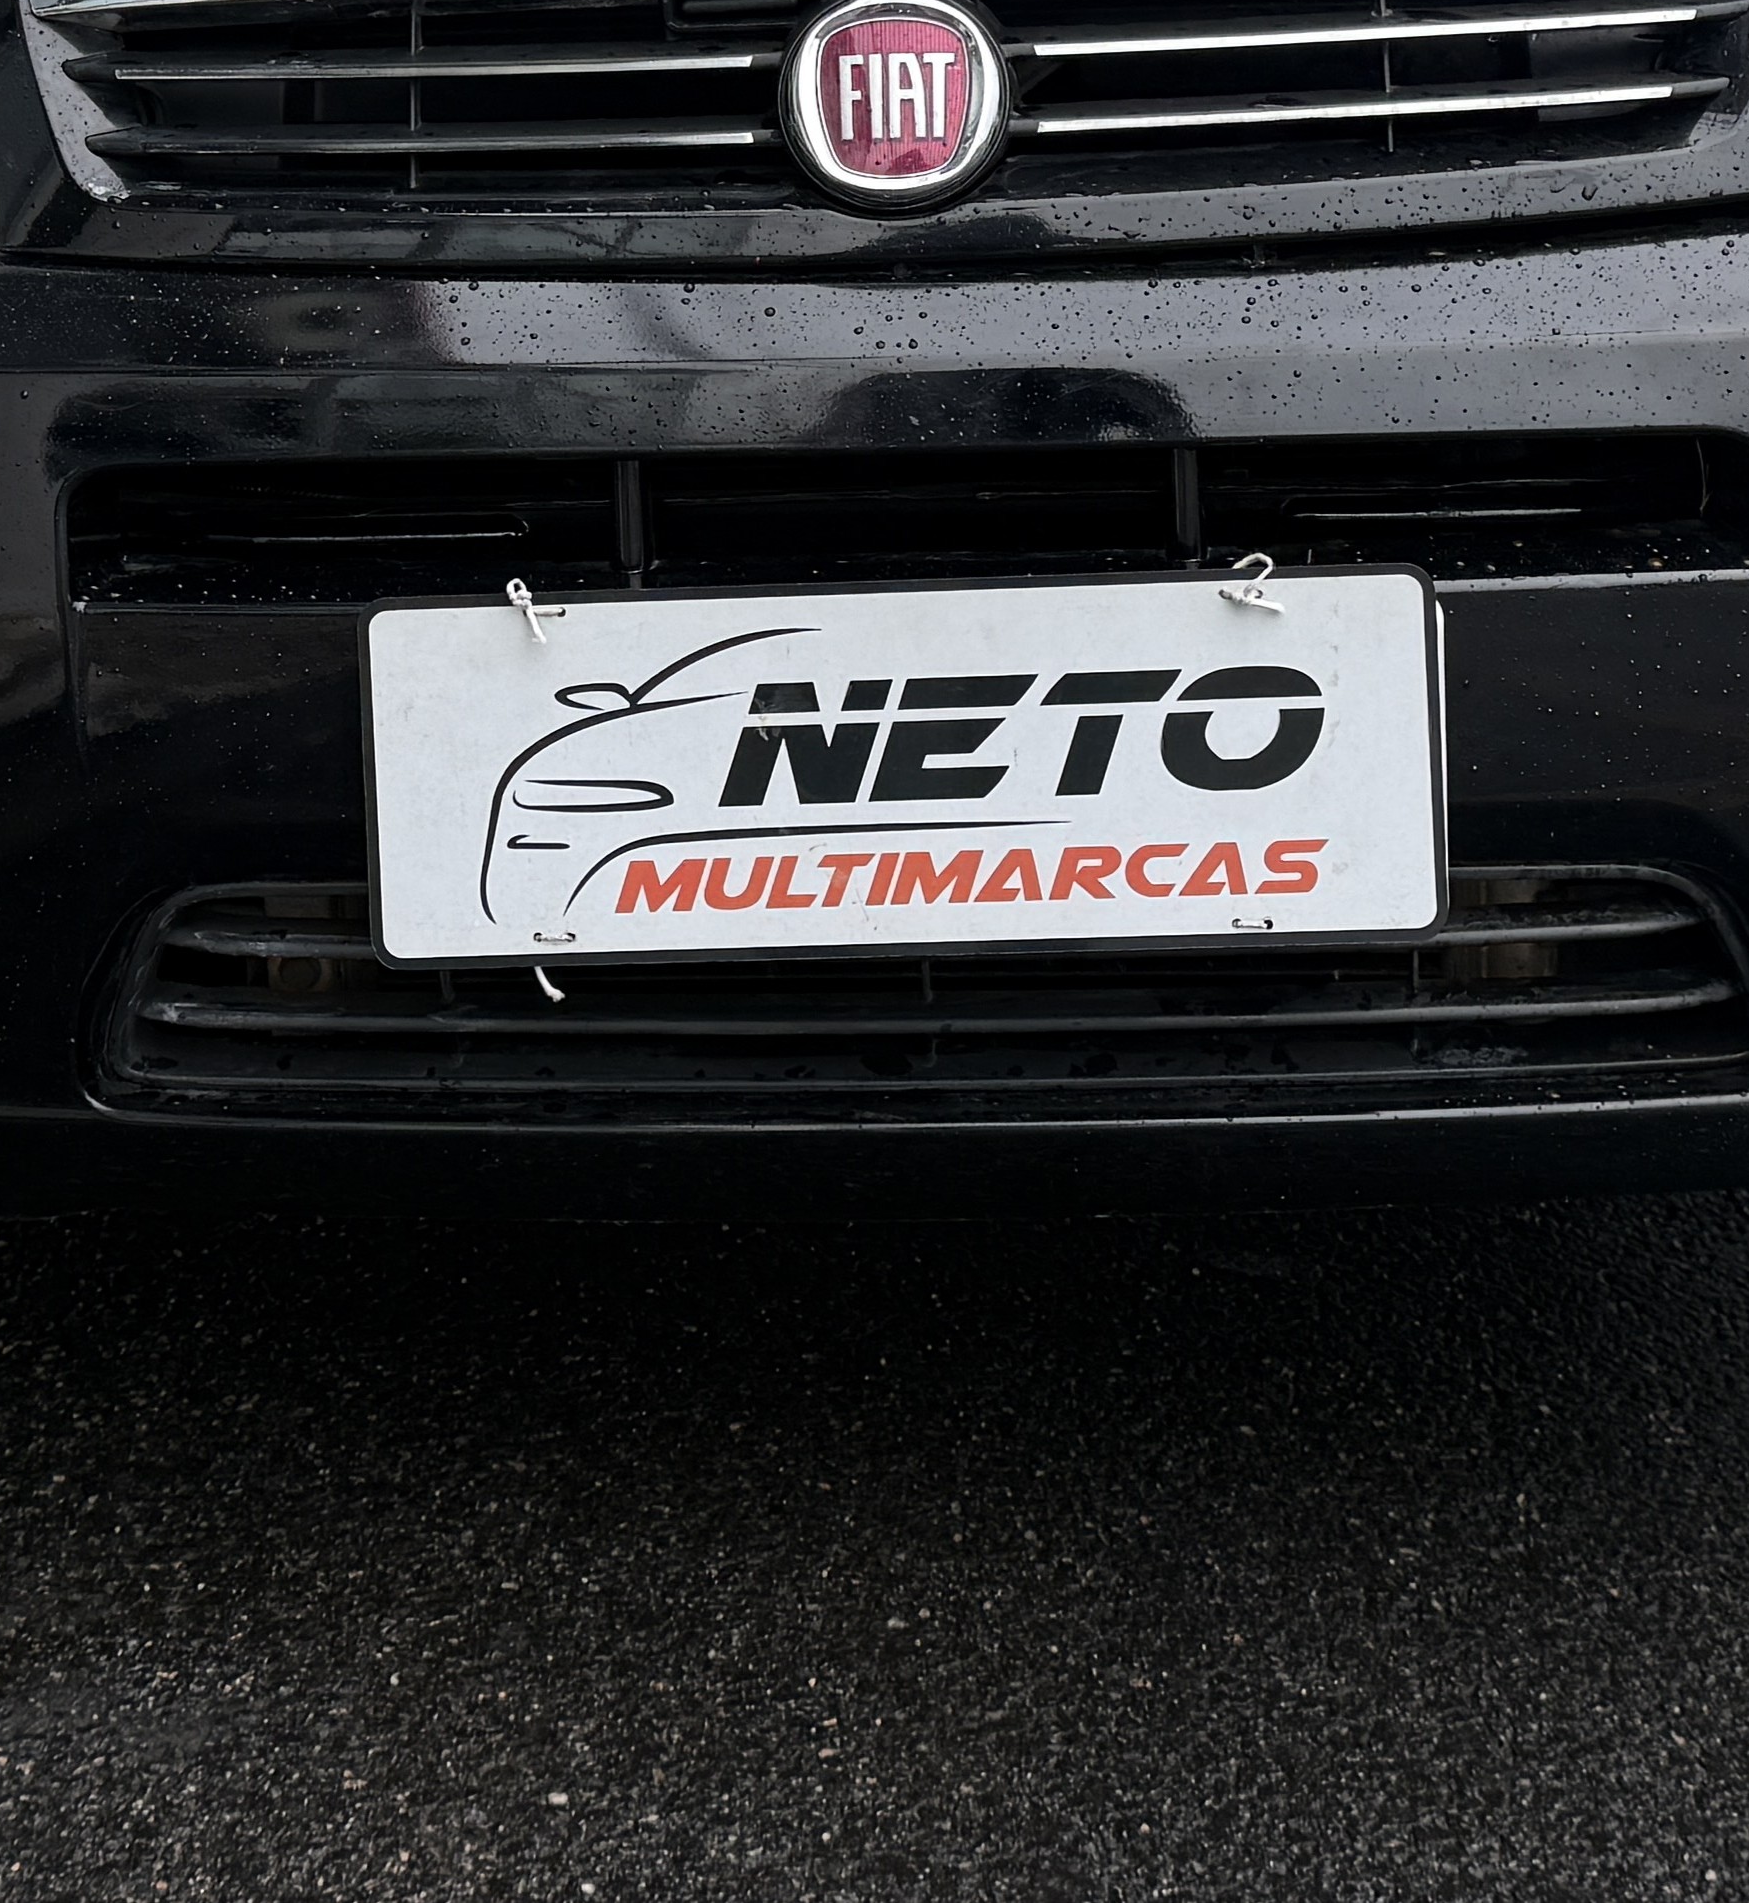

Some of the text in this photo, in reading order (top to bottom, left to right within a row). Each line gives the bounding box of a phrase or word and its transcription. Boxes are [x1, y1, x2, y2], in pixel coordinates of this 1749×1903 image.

[837, 51, 956, 141] FIAT
[718, 665, 1326, 809] NETO
[615, 838, 1329, 915] MULTIMARCAS
